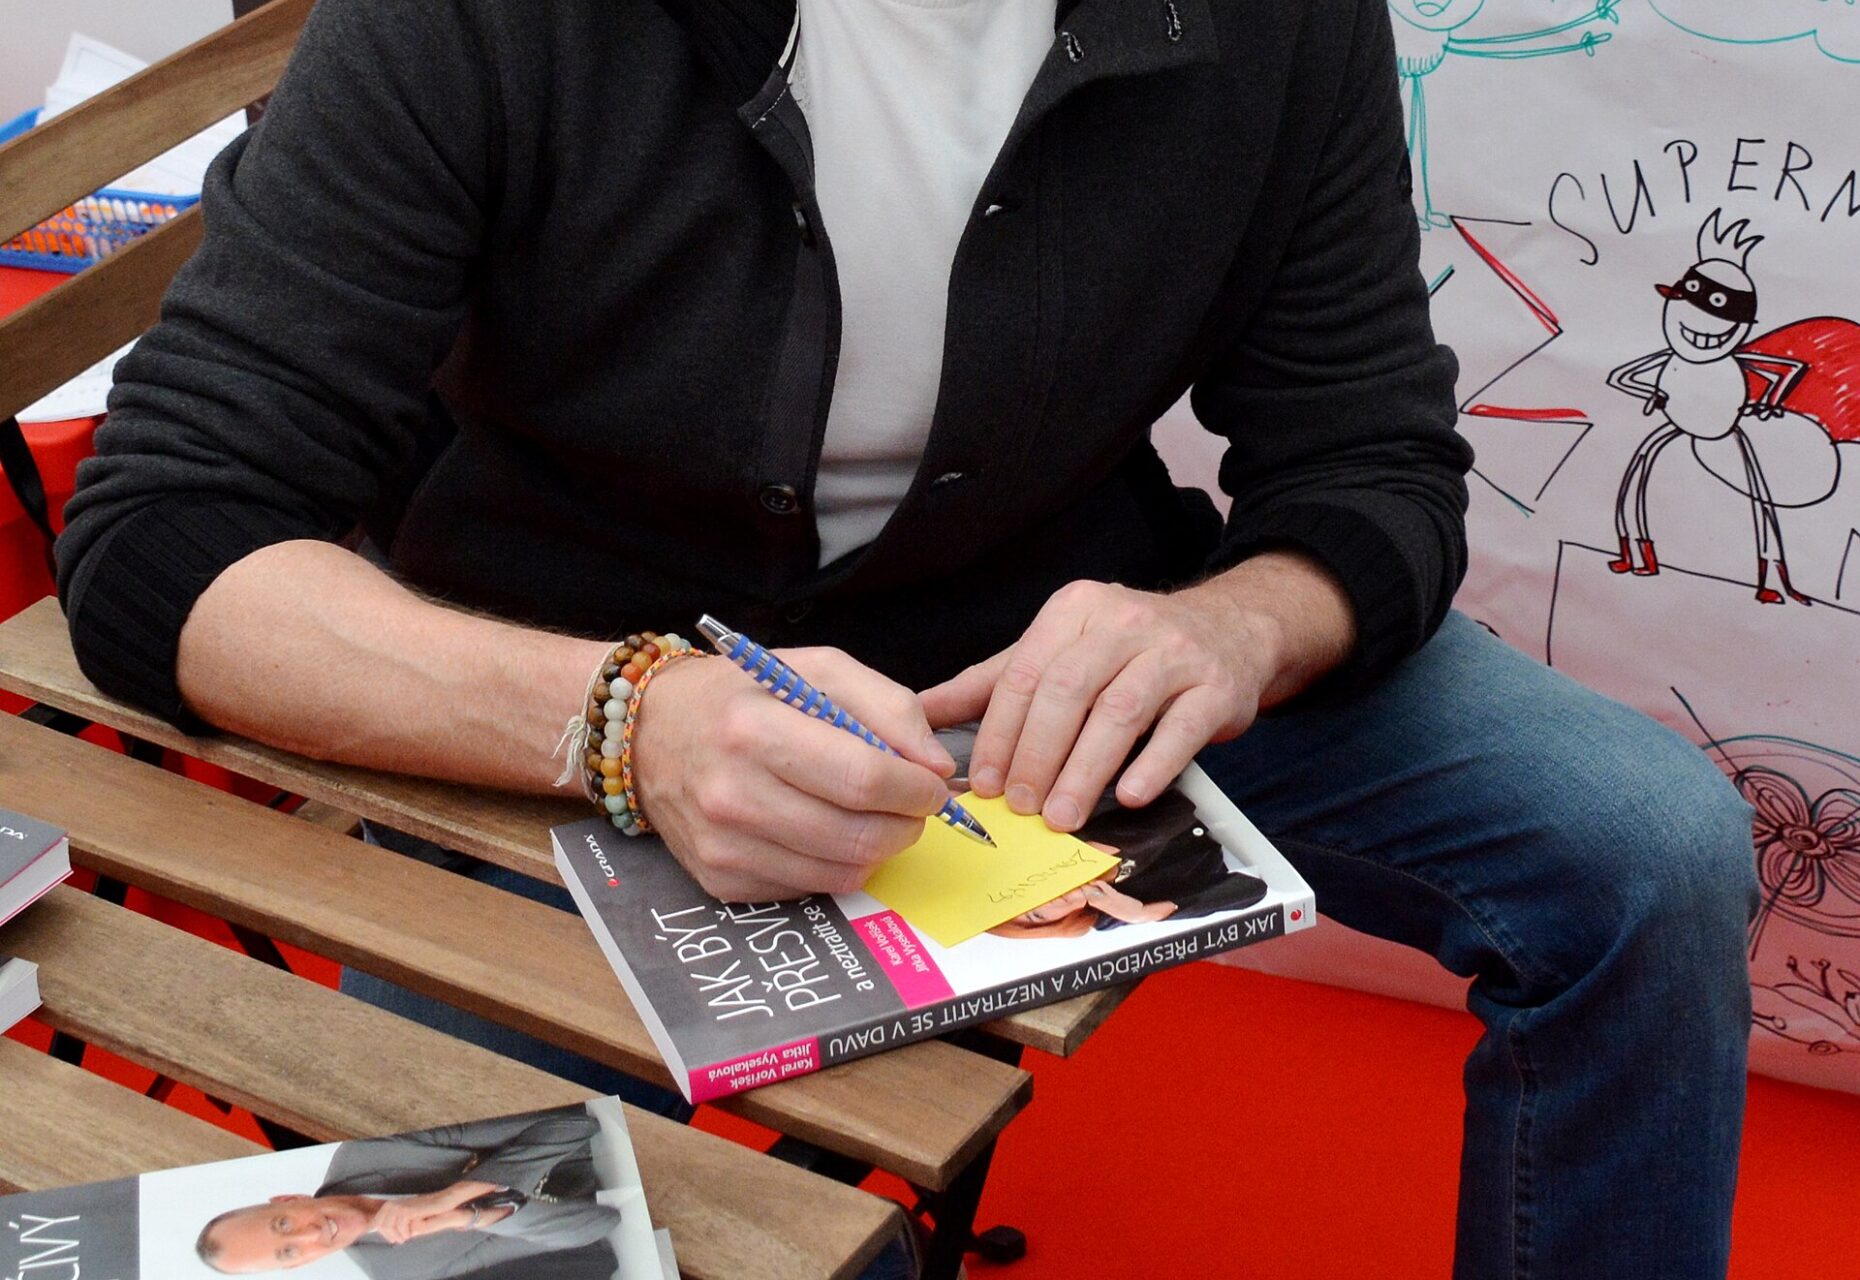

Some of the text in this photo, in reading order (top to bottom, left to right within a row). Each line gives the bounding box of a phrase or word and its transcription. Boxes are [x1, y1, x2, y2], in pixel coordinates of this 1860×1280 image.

[584, 833, 616, 879] GRADA
[803, 904, 827, 921] se
[651, 906, 774, 1020] JAK BÝT
[813, 919, 868, 982] neztratit
[863, 919, 904, 968] Karel Voříšek
[879, 914, 930, 974] Jitka Vysekalová
[828, 913, 1277, 1058] JAK BÝT PŘESVĚDČIVÝ A NEZTRATIT SE V DAVU
[856, 980, 875, 993] a
[707, 1042, 812, 1082] Jitka Vysekalová
[730, 1057, 814, 1090] Karel Voříšek
